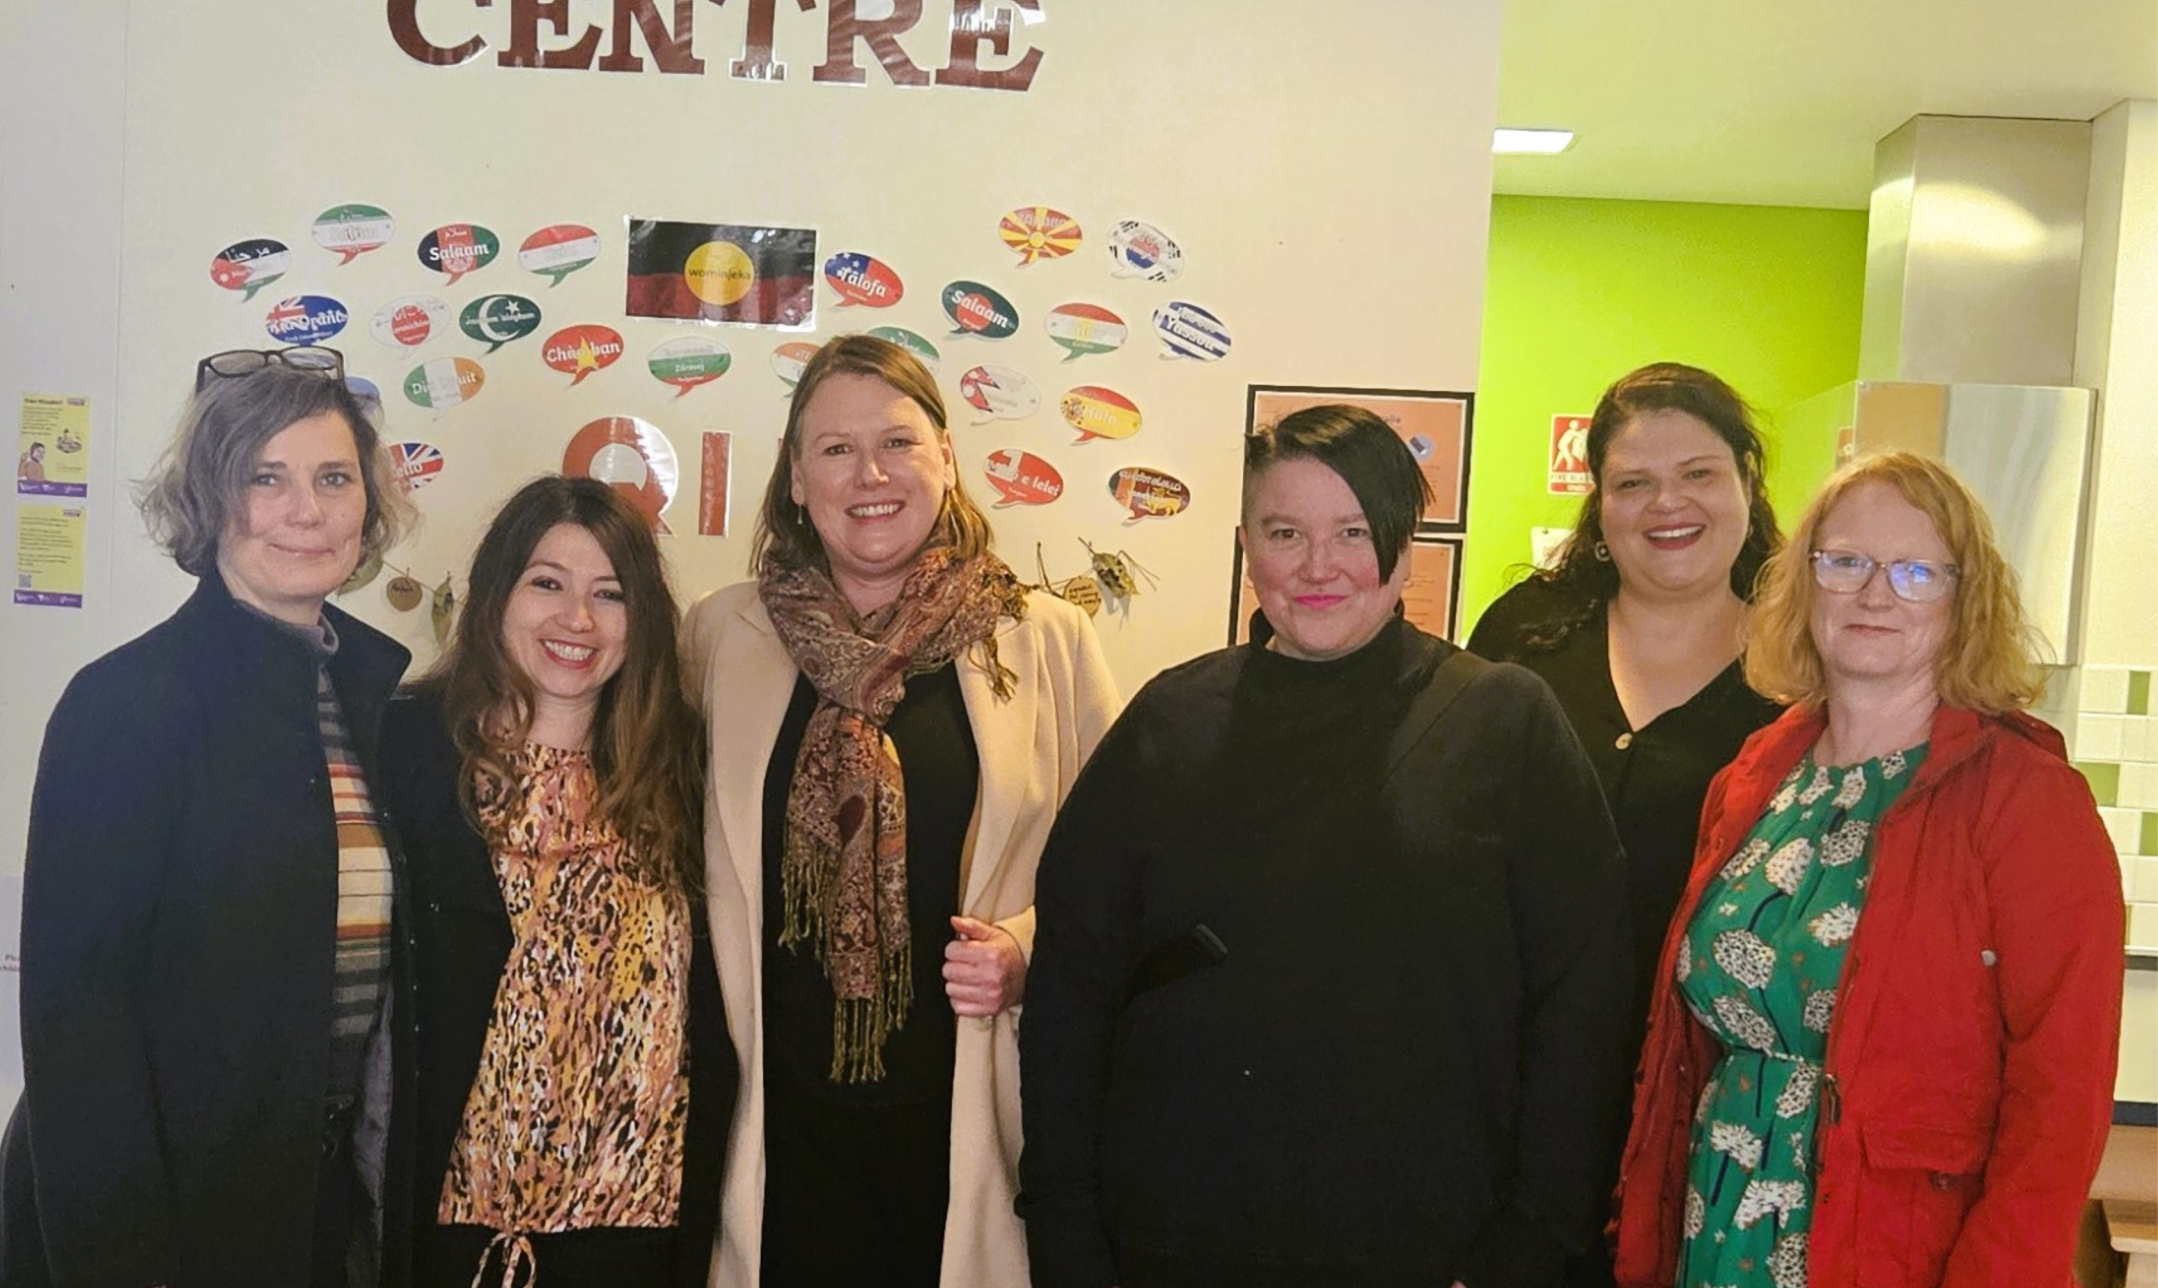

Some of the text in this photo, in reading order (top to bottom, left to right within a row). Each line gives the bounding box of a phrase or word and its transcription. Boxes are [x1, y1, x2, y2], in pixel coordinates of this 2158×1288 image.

[387, 0, 1045, 92] CENTRE
[428, 243, 490, 261] Salaam
[688, 269, 752, 281] wominjeka
[951, 289, 1009, 328] Salaam
[547, 341, 620, 362] Chào bạn
[1021, 476, 1030, 486] e
[1032, 476, 1060, 497] lelei
